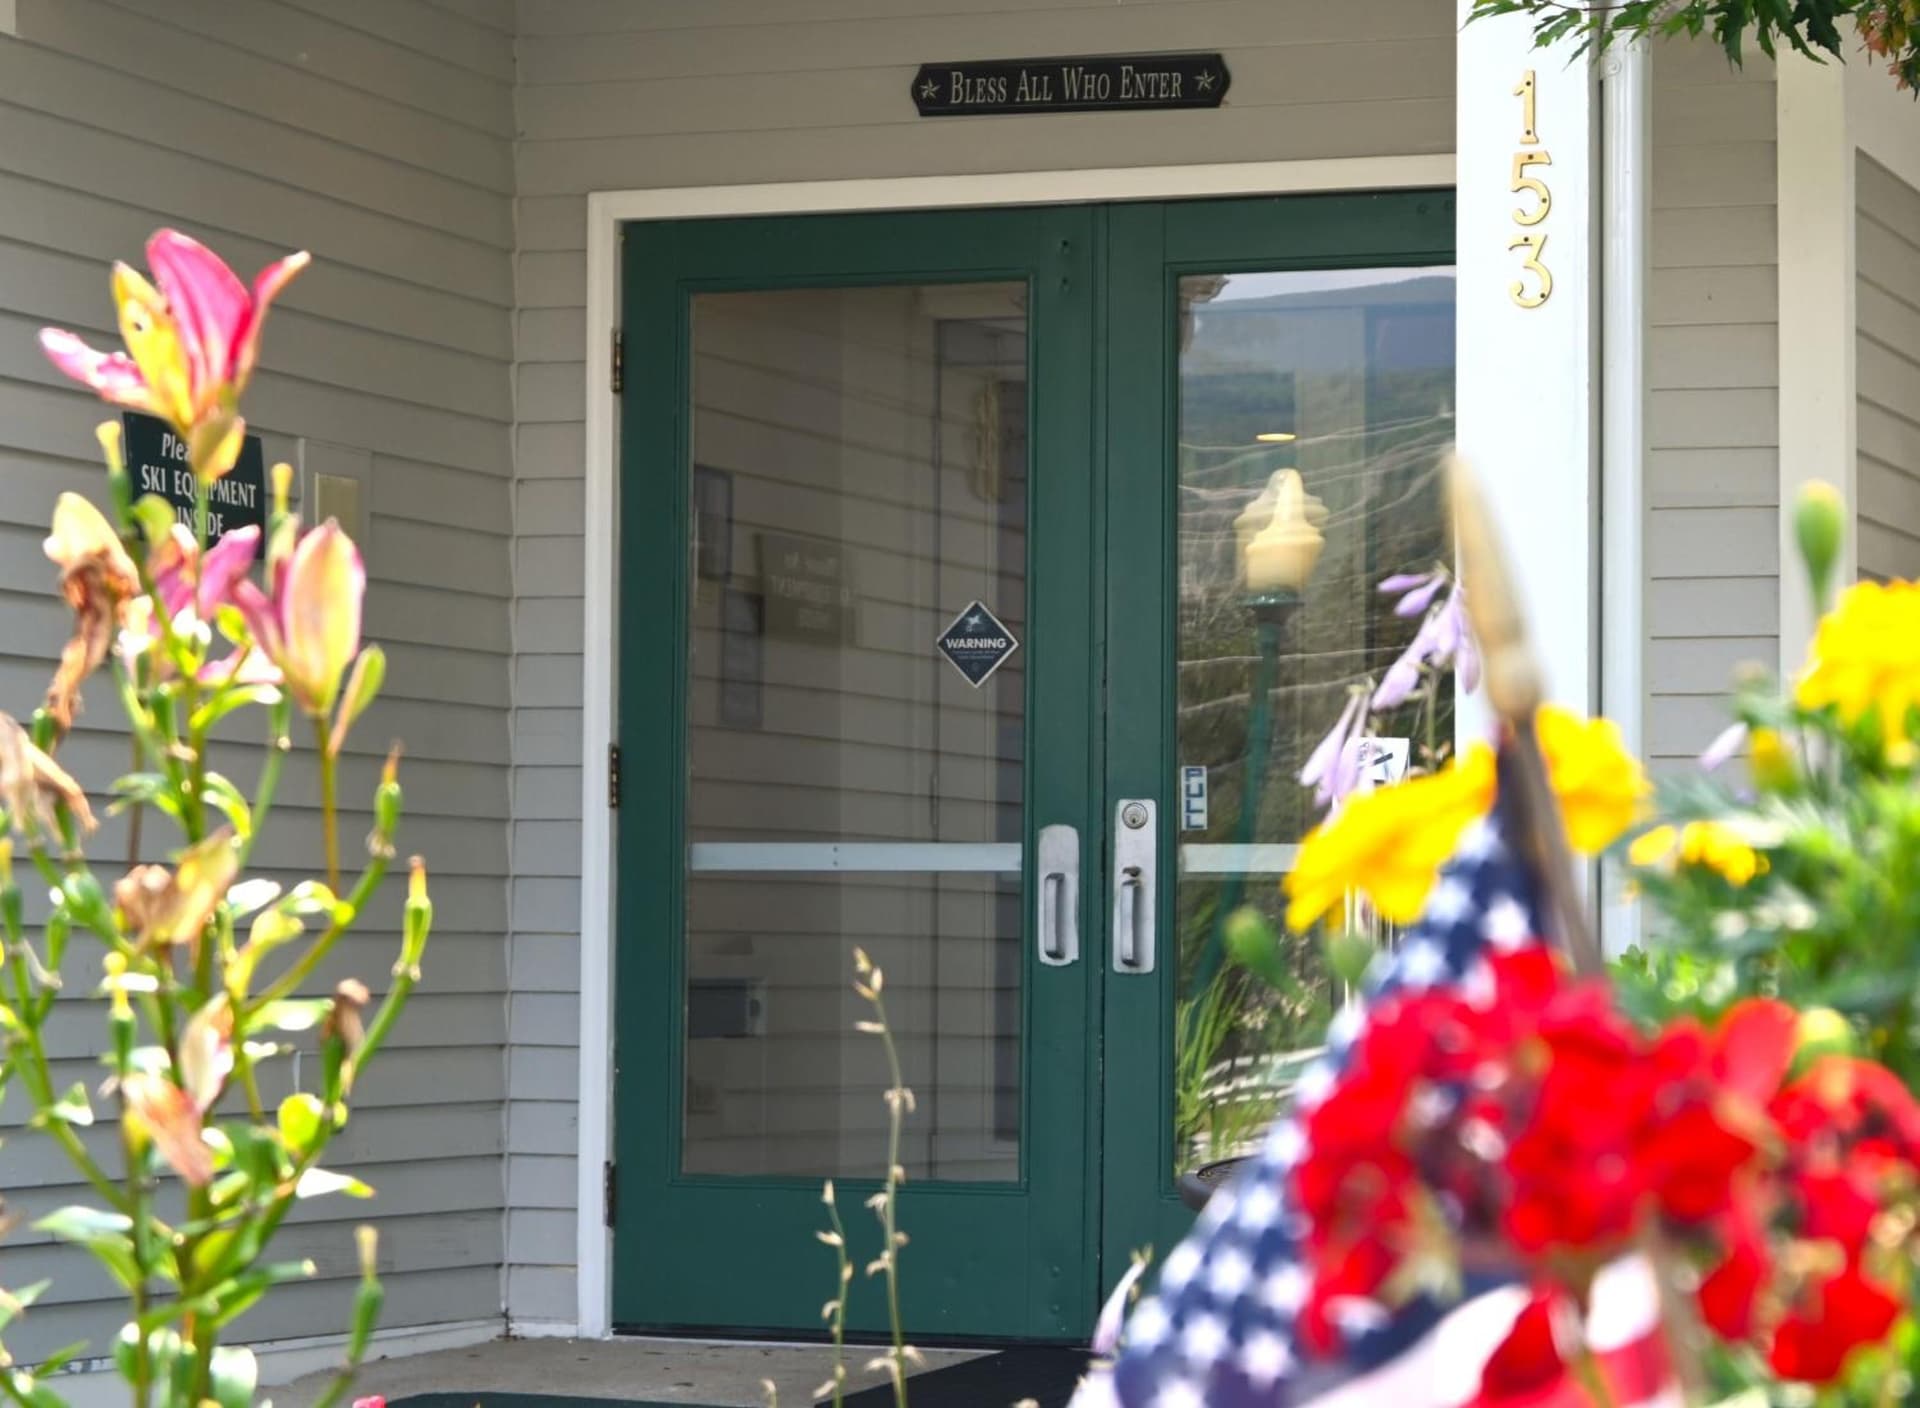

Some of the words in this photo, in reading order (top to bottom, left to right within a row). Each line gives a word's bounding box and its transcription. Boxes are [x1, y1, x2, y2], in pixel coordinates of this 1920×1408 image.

[950, 71, 1007, 104] BLESS
[1015, 69, 1053, 102] ALL
[1061, 66, 1110, 101] WHO
[1120, 65, 1182, 98] ENTER
[1508, 70, 1553, 309] 153
[161, 432, 192, 461] Plea
[141, 463, 166, 492] SKI
[945, 638, 1007, 649] WARNING
[1185, 767, 1204, 829] PULL
